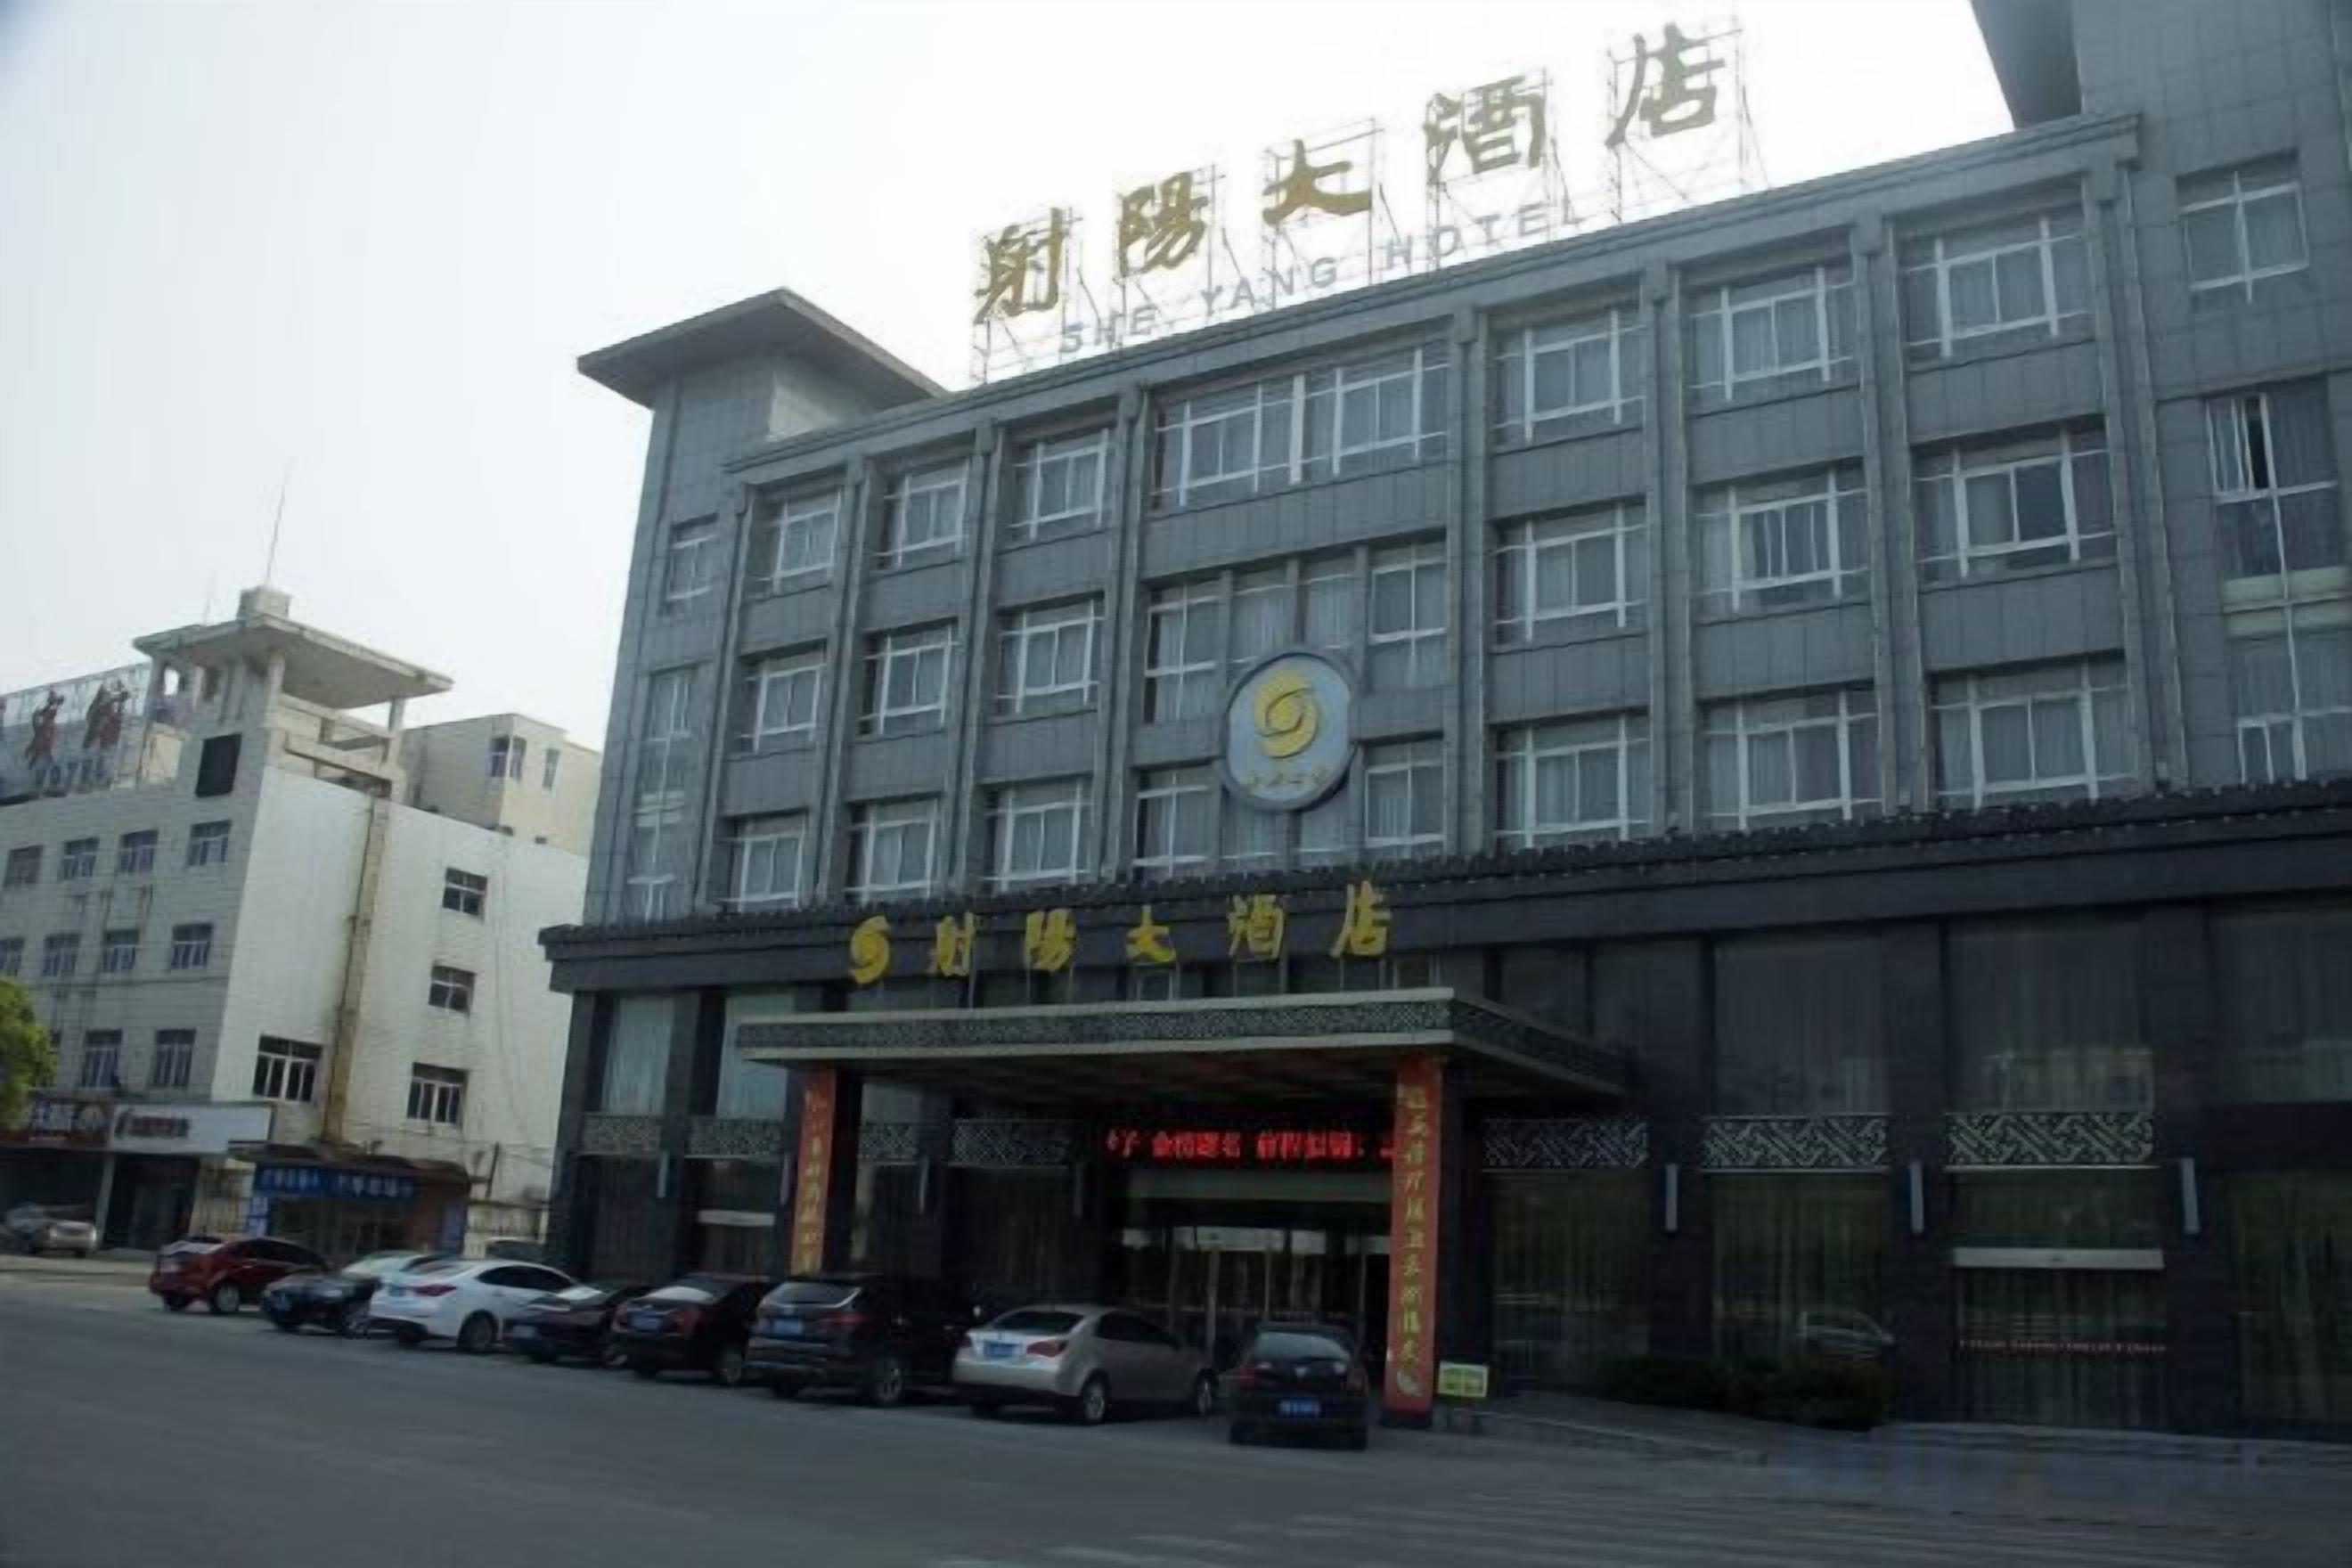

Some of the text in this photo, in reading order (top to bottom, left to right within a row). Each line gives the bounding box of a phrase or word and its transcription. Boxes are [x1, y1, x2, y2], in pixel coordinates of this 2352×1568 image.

[1059, 192, 1585, 354] SHE YANG HOTEL
